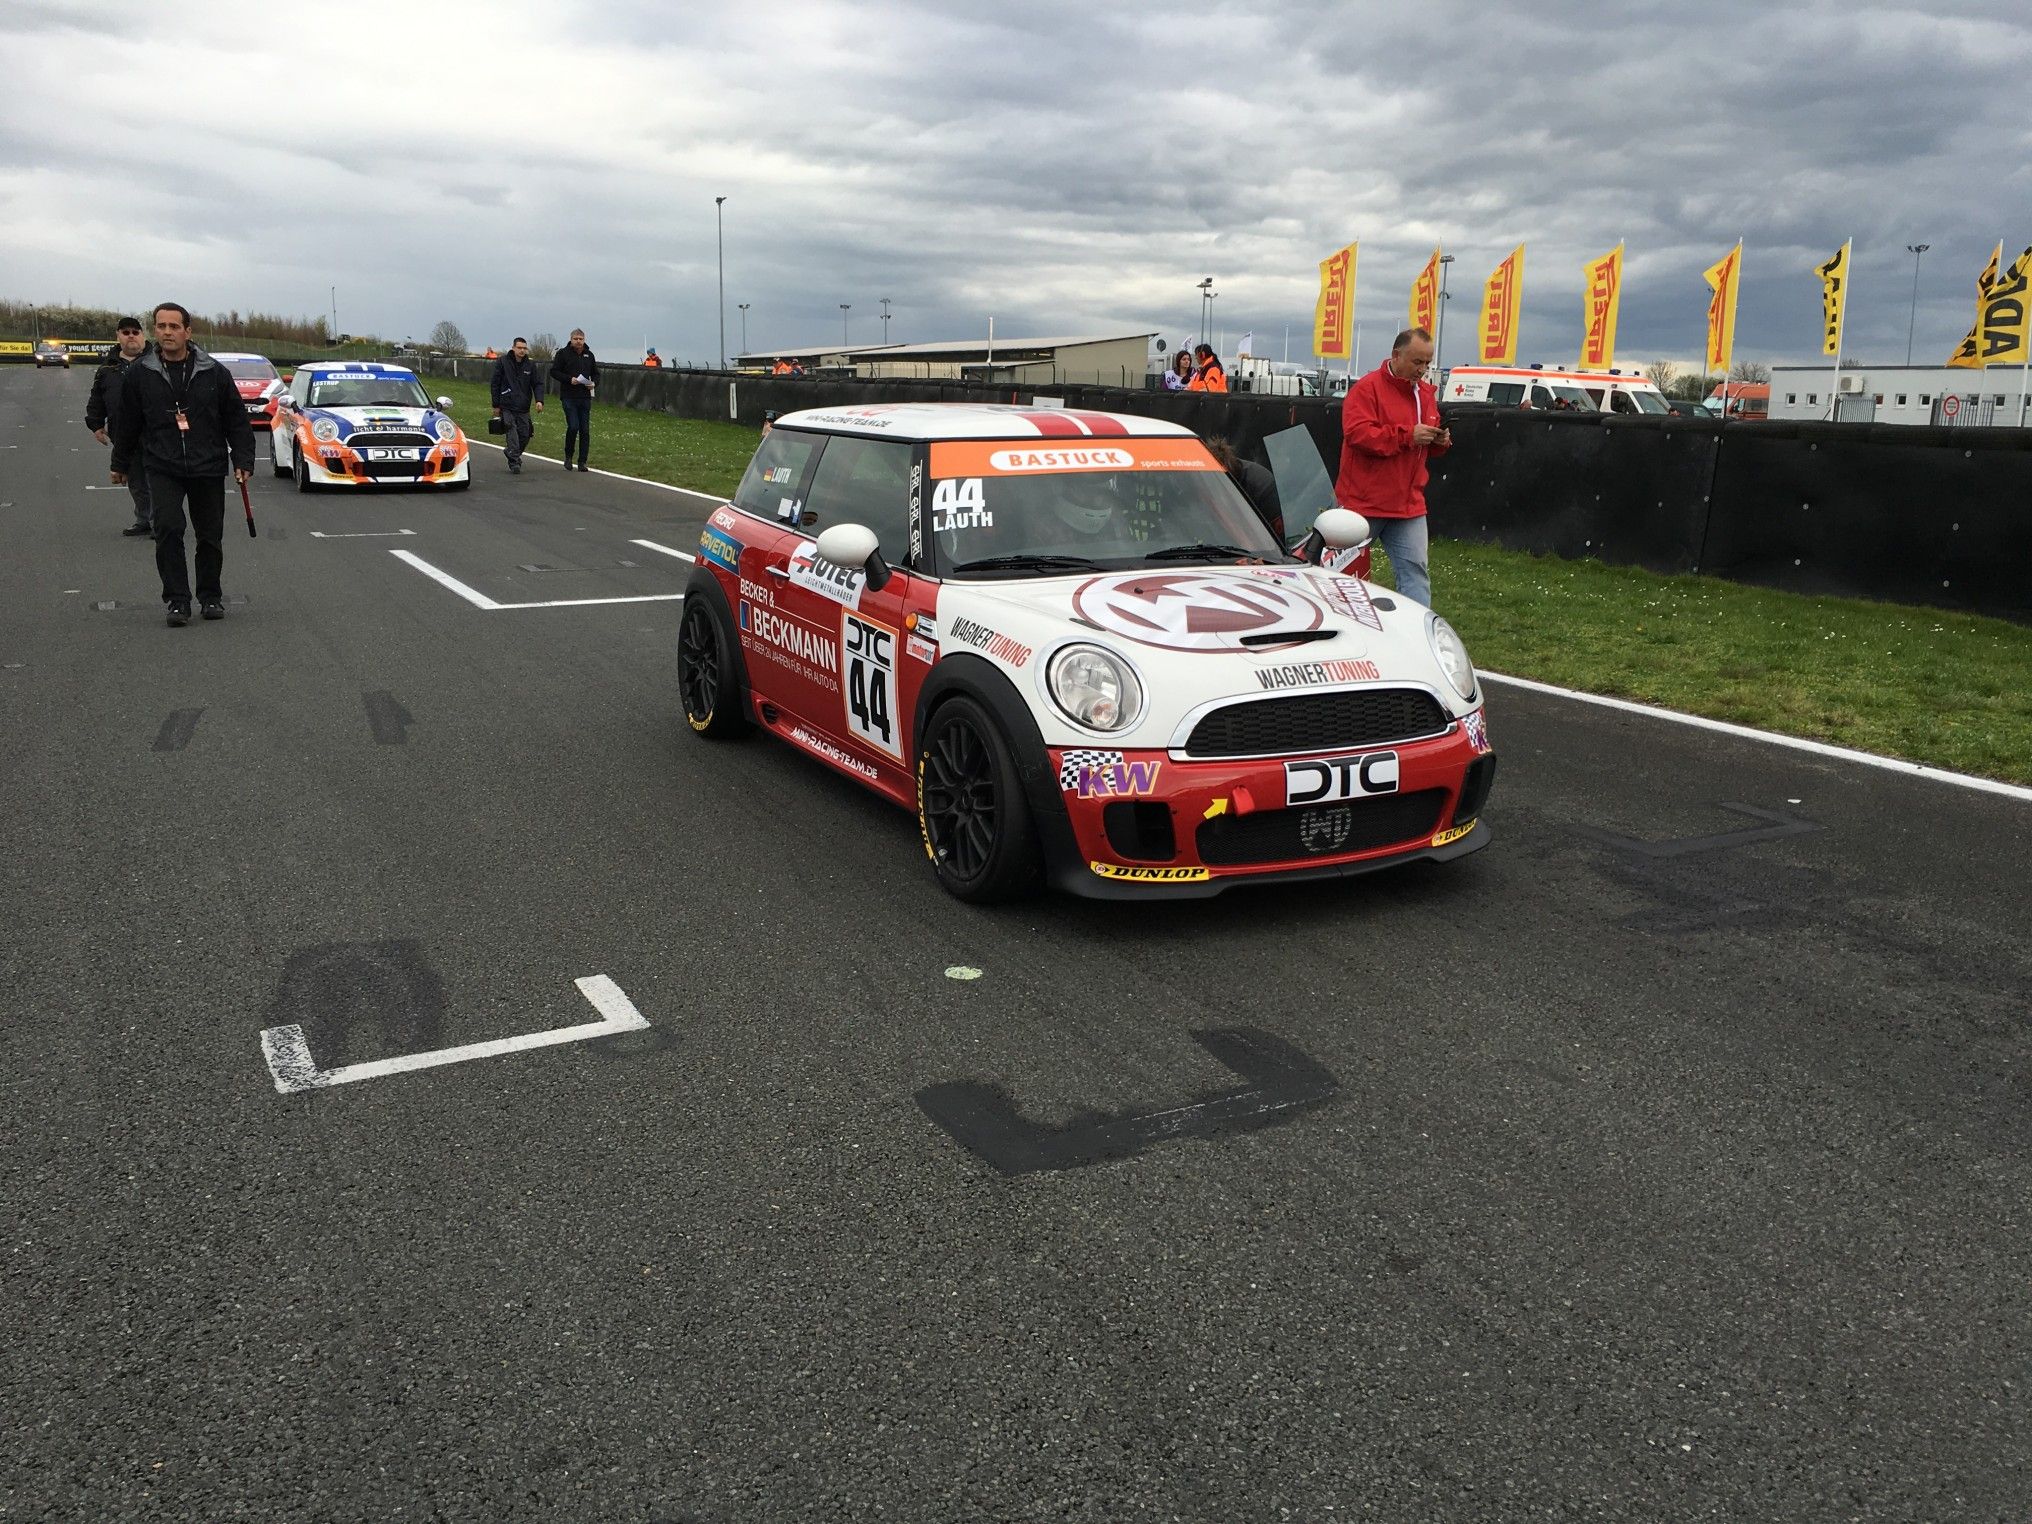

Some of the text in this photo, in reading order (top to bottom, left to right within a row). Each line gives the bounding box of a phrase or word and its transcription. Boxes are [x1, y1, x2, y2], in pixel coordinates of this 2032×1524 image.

[375, 449, 412, 459] DTC
[1008, 452, 1122, 467] BASTUCK
[1141, 460, 1169, 468] sports
[932, 478, 985, 515] 44
[933, 512, 993, 532] LAUTH
[798, 552, 865, 591] AUTEC
[740, 578, 775, 608] BECKER &
[753, 607, 837, 673] BECKMANN
[847, 616, 891, 667] DTC
[950, 616, 1031, 667] WAGNERTUNING
[814, 671, 829, 688] AUTO
[1254, 660, 1380, 689] WAGNERTUNING
[849, 658, 890, 744] 44
[1077, 761, 1161, 799] KW
[1288, 751, 1398, 804] DTC
[1112, 866, 1207, 879] DUNLOP
